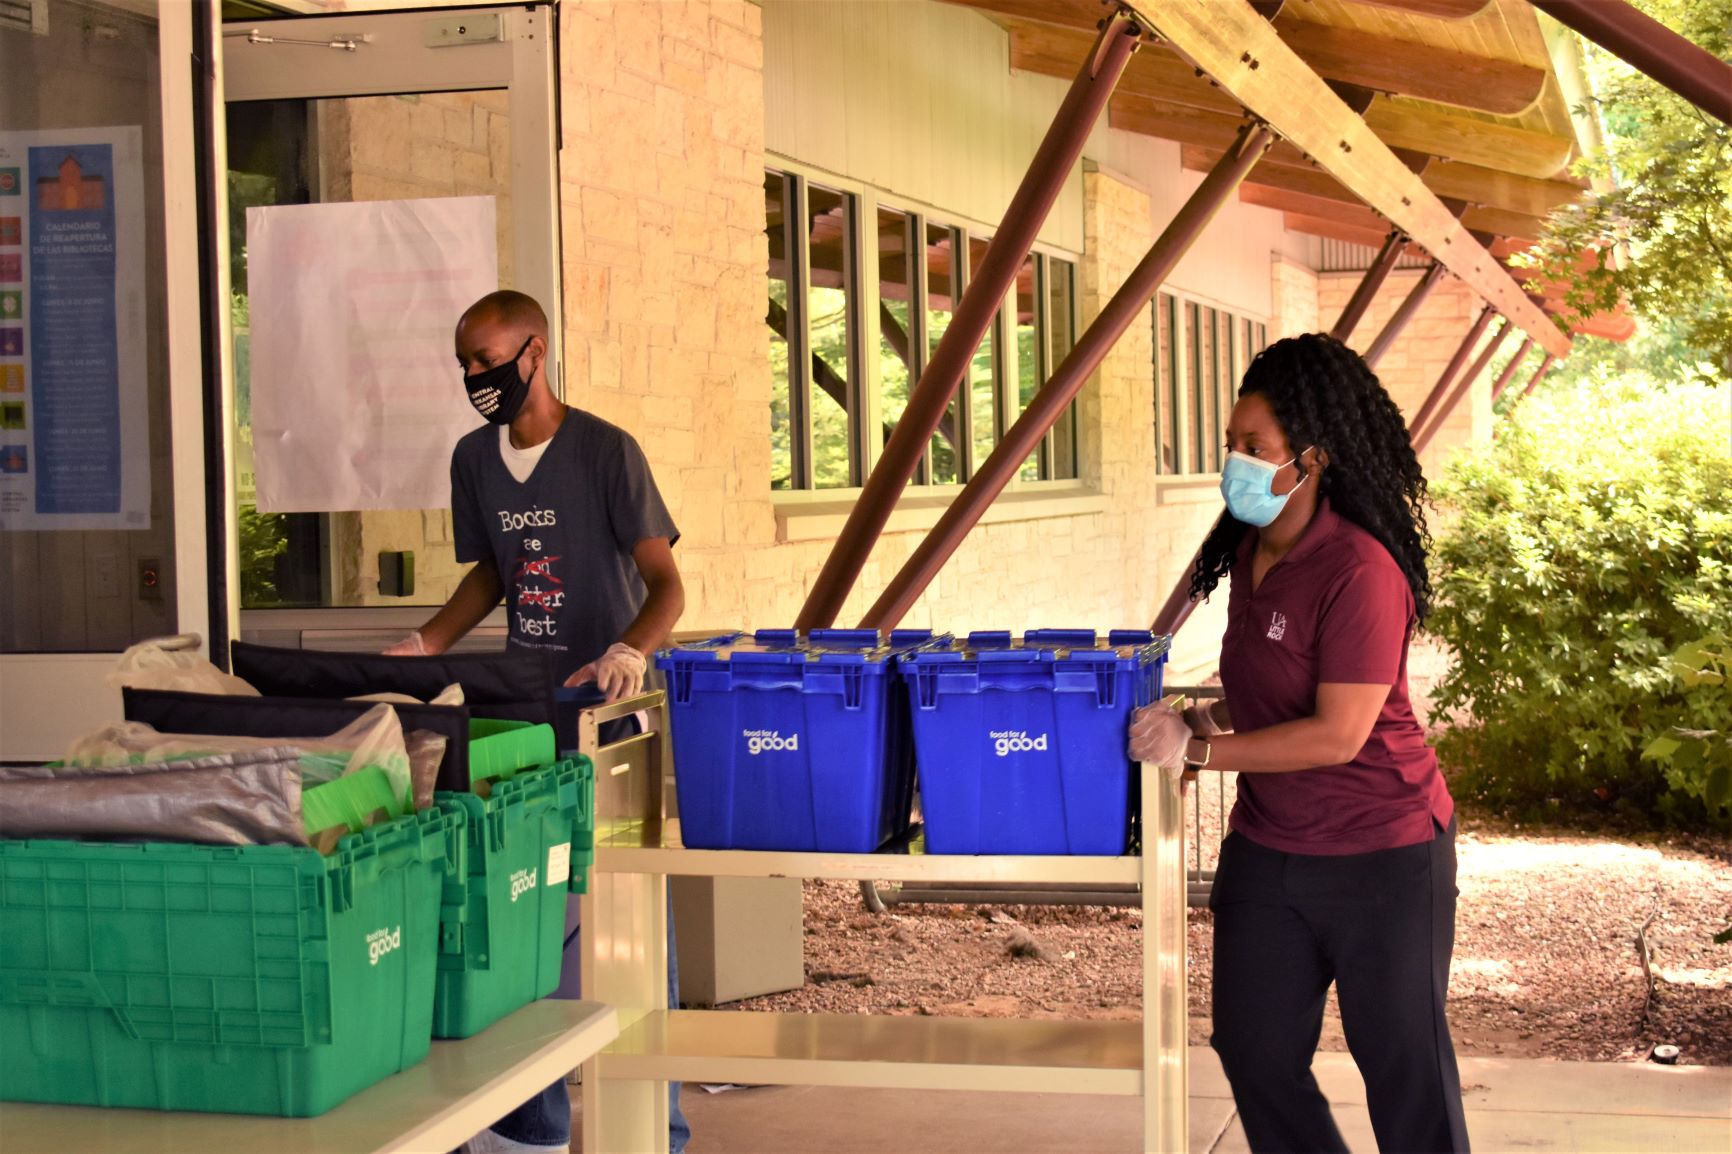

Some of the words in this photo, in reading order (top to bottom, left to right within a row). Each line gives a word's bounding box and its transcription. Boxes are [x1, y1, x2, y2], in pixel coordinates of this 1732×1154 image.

[45, 222, 102, 232] CALENDARIO
[40, 235, 52, 243] DE
[53, 232, 108, 243] REAPERTURA
[63, 243, 113, 254] BIBLIOTECAS
[471, 386, 495, 399] ENTRAL
[523, 538, 542, 551] ae
[516, 612, 557, 636] best
[743, 729, 761, 737] food
[761, 729, 772, 737] for
[989, 730, 1009, 739] food
[1009, 730, 1020, 738] for
[748, 733, 798, 755] good
[995, 733, 1048, 757] good
[511, 867, 536, 902] good
[369, 925, 401, 966] good
